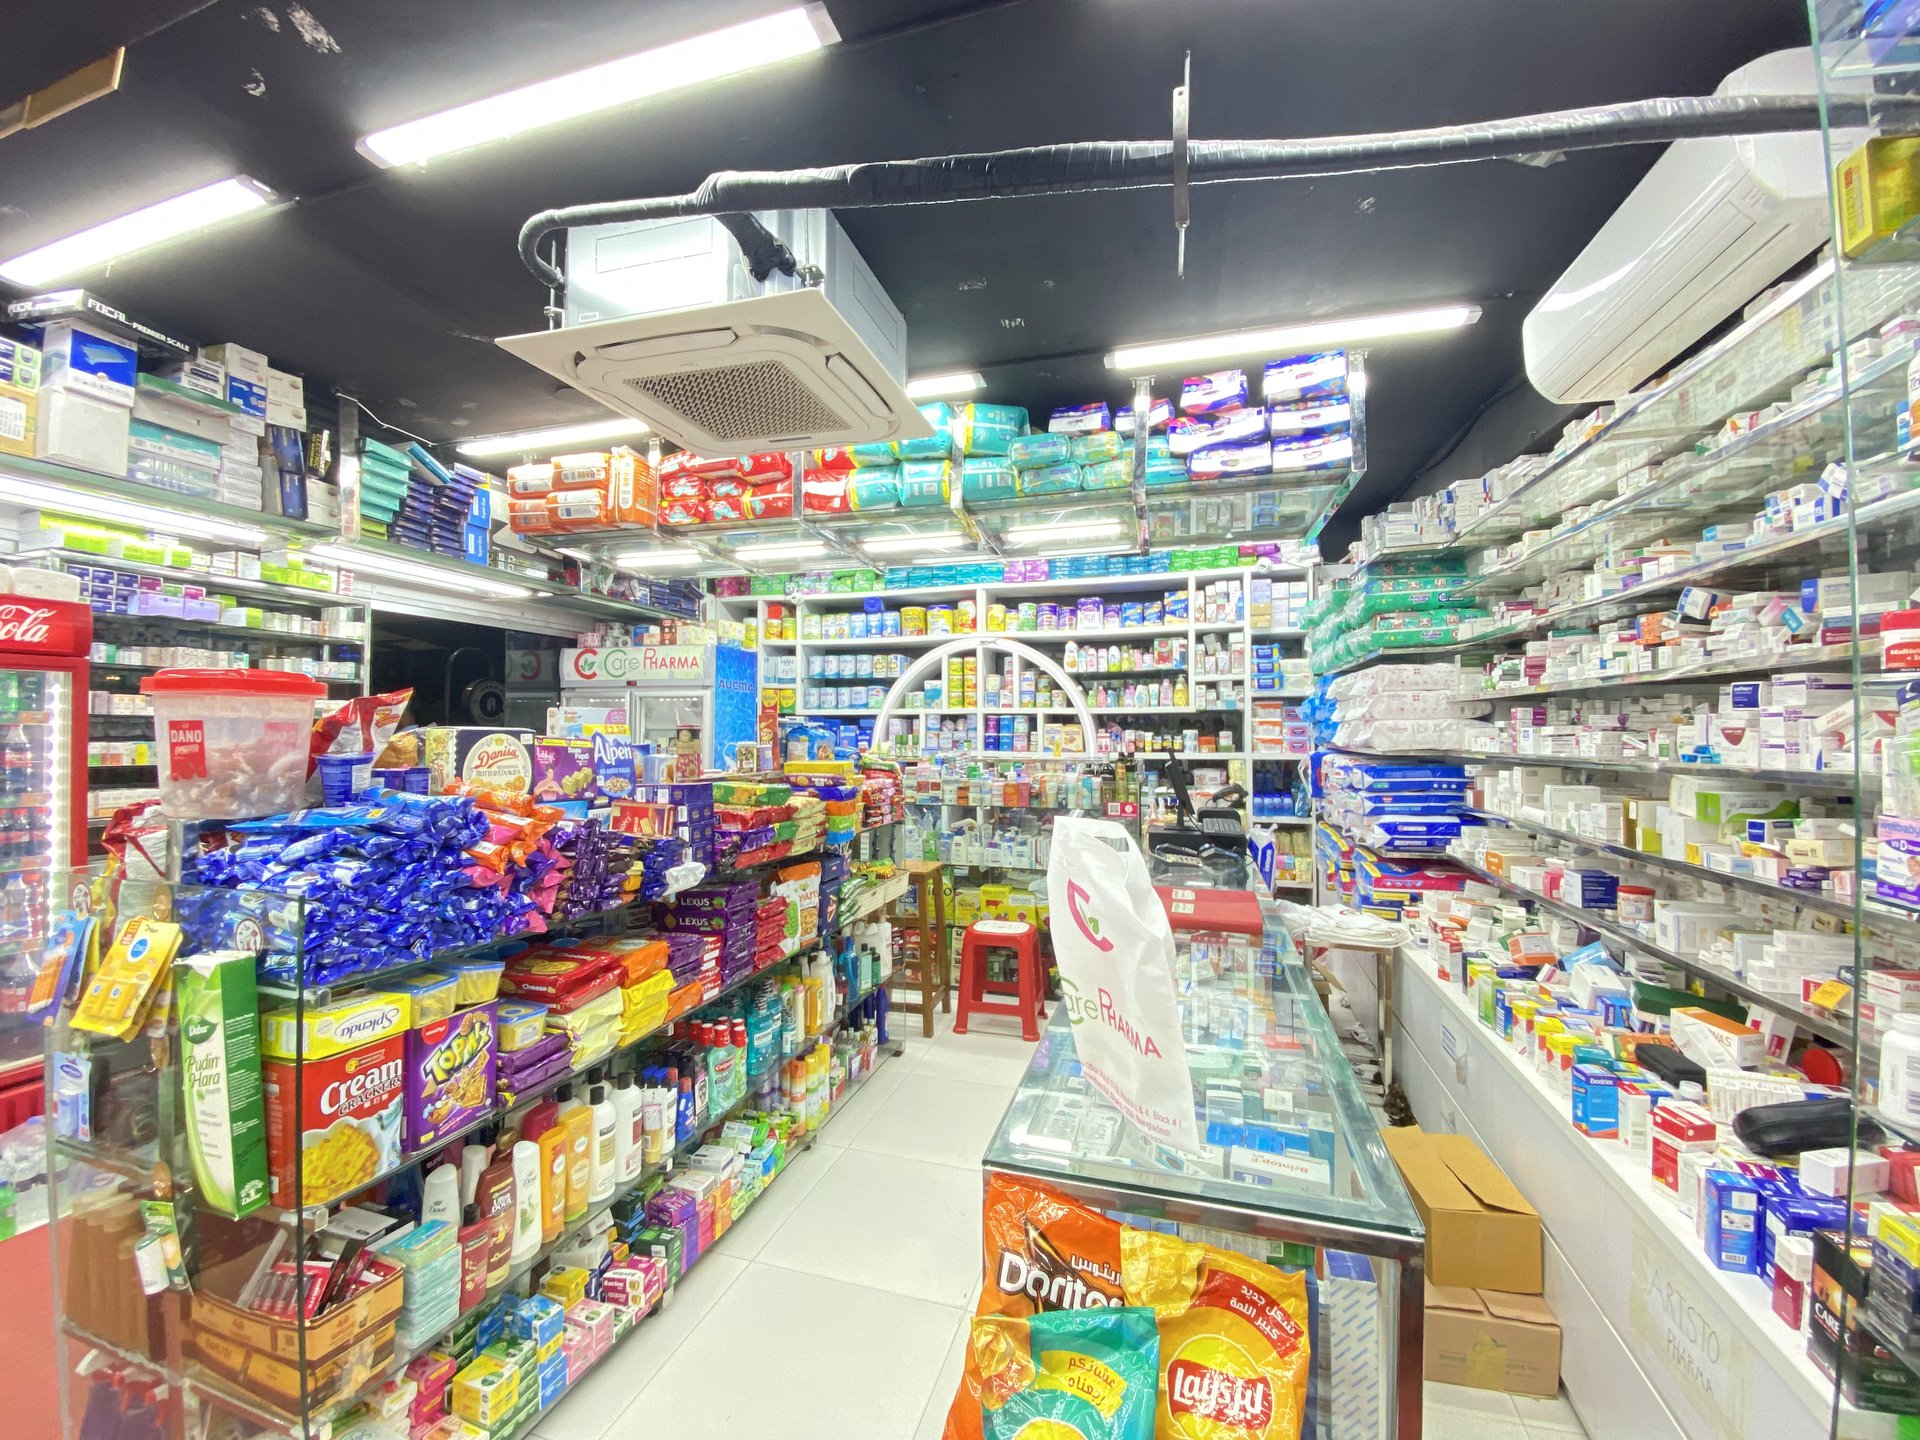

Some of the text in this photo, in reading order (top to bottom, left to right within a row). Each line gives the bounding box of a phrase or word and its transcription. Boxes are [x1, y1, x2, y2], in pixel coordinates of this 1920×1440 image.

[87, 298, 190, 353] FOCAL PREMIER SCALE
[604, 648, 700, 678] Care PHARMA
[718, 680, 754, 693] AUCMA
[171, 730, 202, 742] DANO
[474, 745, 519, 769] Danisa
[594, 736, 633, 765] Alpen
[680, 897, 710, 906] LEXUS
[958, 901, 976, 909] NIDO
[679, 917, 709, 925] LEXUS
[188, 1024, 210, 1037] Dabur
[340, 1008, 400, 1039] Splenda
[1098, 987, 1163, 1059] PHARMA
[186, 1055, 221, 1074] Pudin
[189, 1071, 221, 1089] Hara
[320, 1058, 403, 1116] Cream
[1589, 1077, 1613, 1085] Dextrim
[339, 1078, 402, 1116] CRACKERS
[1152, 1110, 1171, 1127] Block
[428, 1205, 447, 1215] Dove
[1229, 1297, 1281, 1340] كبير اللمة
[1240, 1285, 1296, 1335] شكل جديد
[1649, 1270, 1720, 1364] ARISTO
[1666, 1328, 1714, 1393] PHARMA
